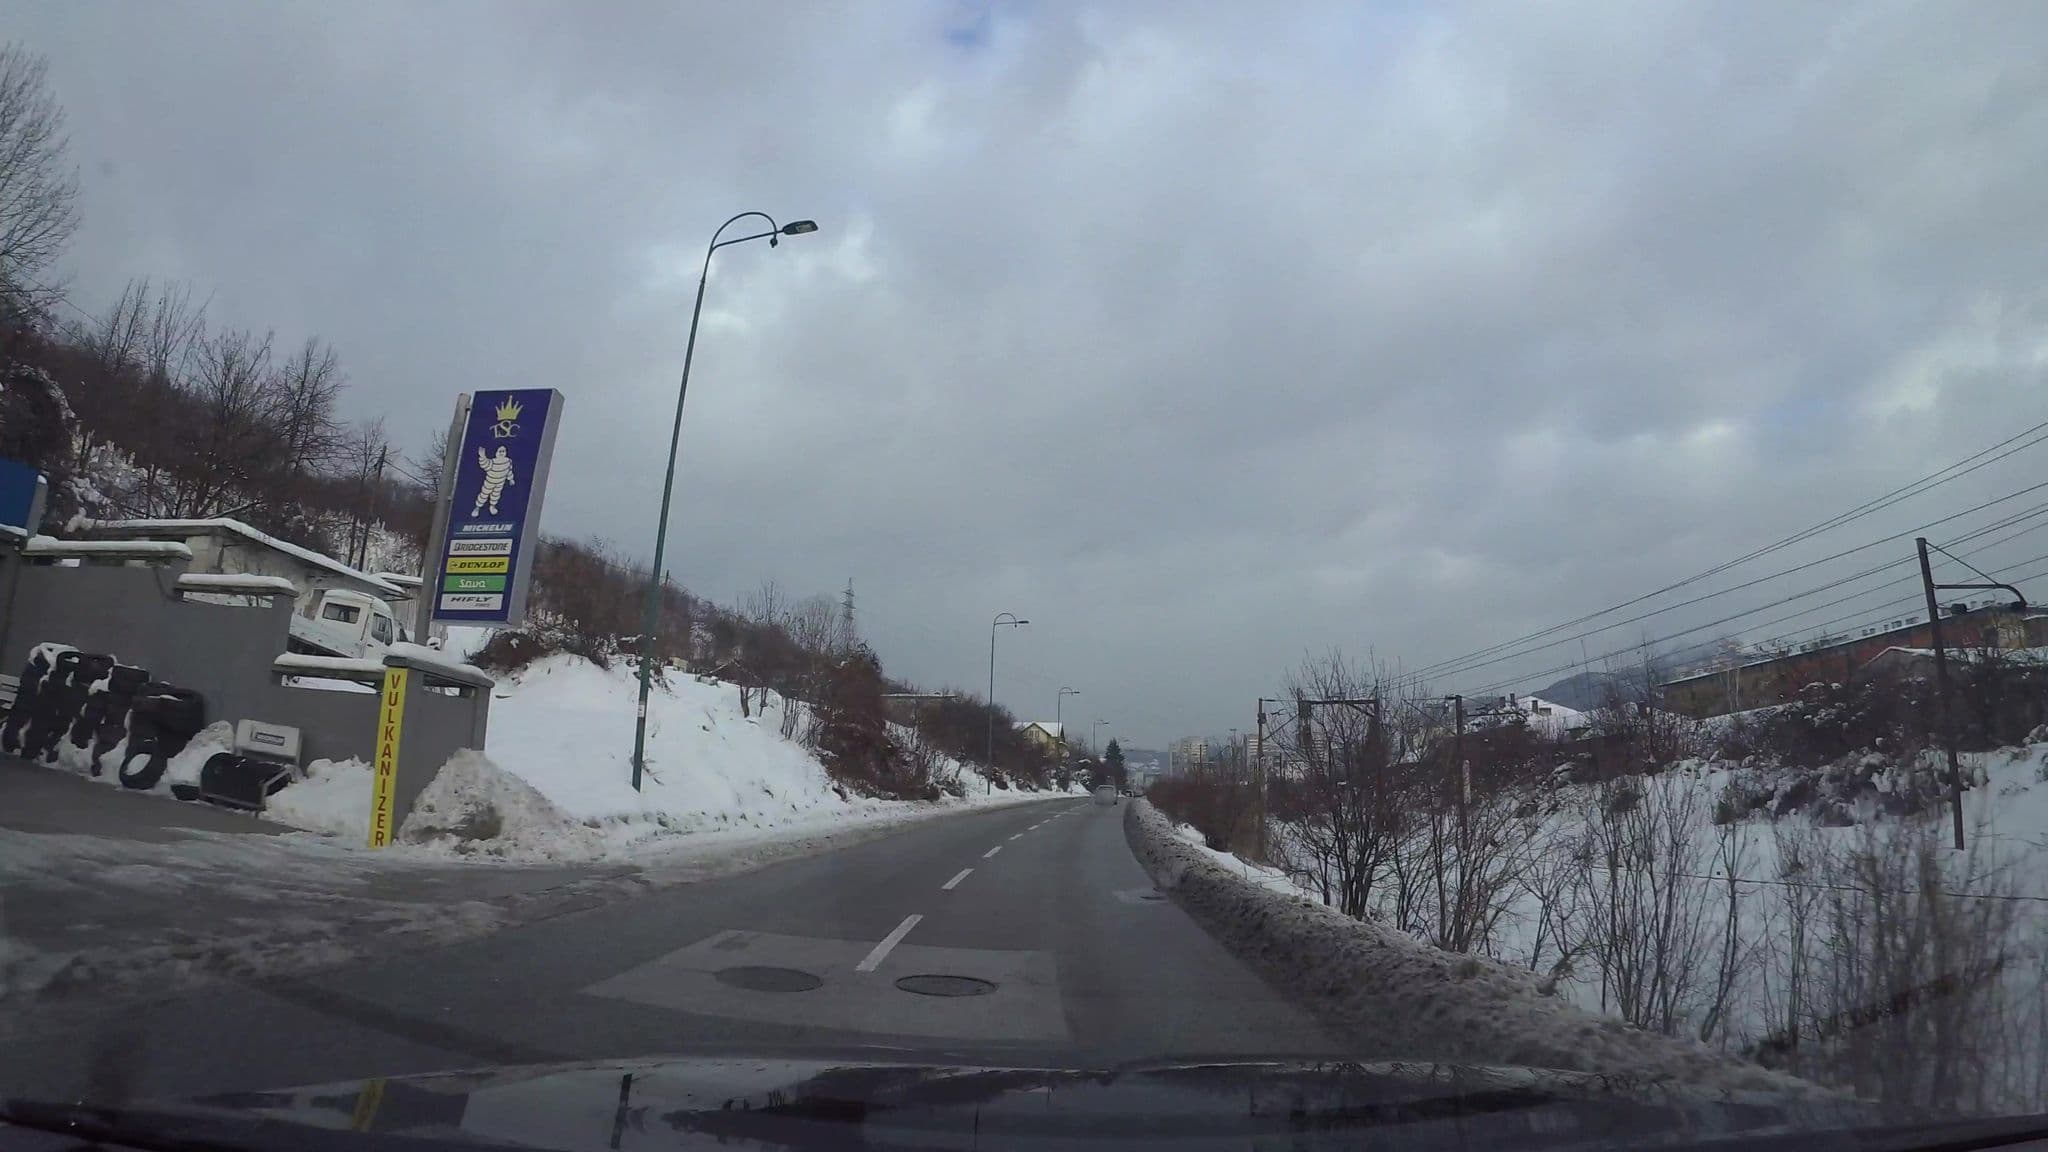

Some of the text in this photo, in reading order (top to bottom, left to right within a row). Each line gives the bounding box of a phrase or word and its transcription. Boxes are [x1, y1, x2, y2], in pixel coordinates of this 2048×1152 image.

[462, 524, 513, 532] MICHELIN
[453, 542, 509, 551] BRIDGESTONE
[458, 561, 505, 569] DUNLOP
[458, 579, 486, 588] Sava
[374, 674, 401, 847] VULKANIZER
